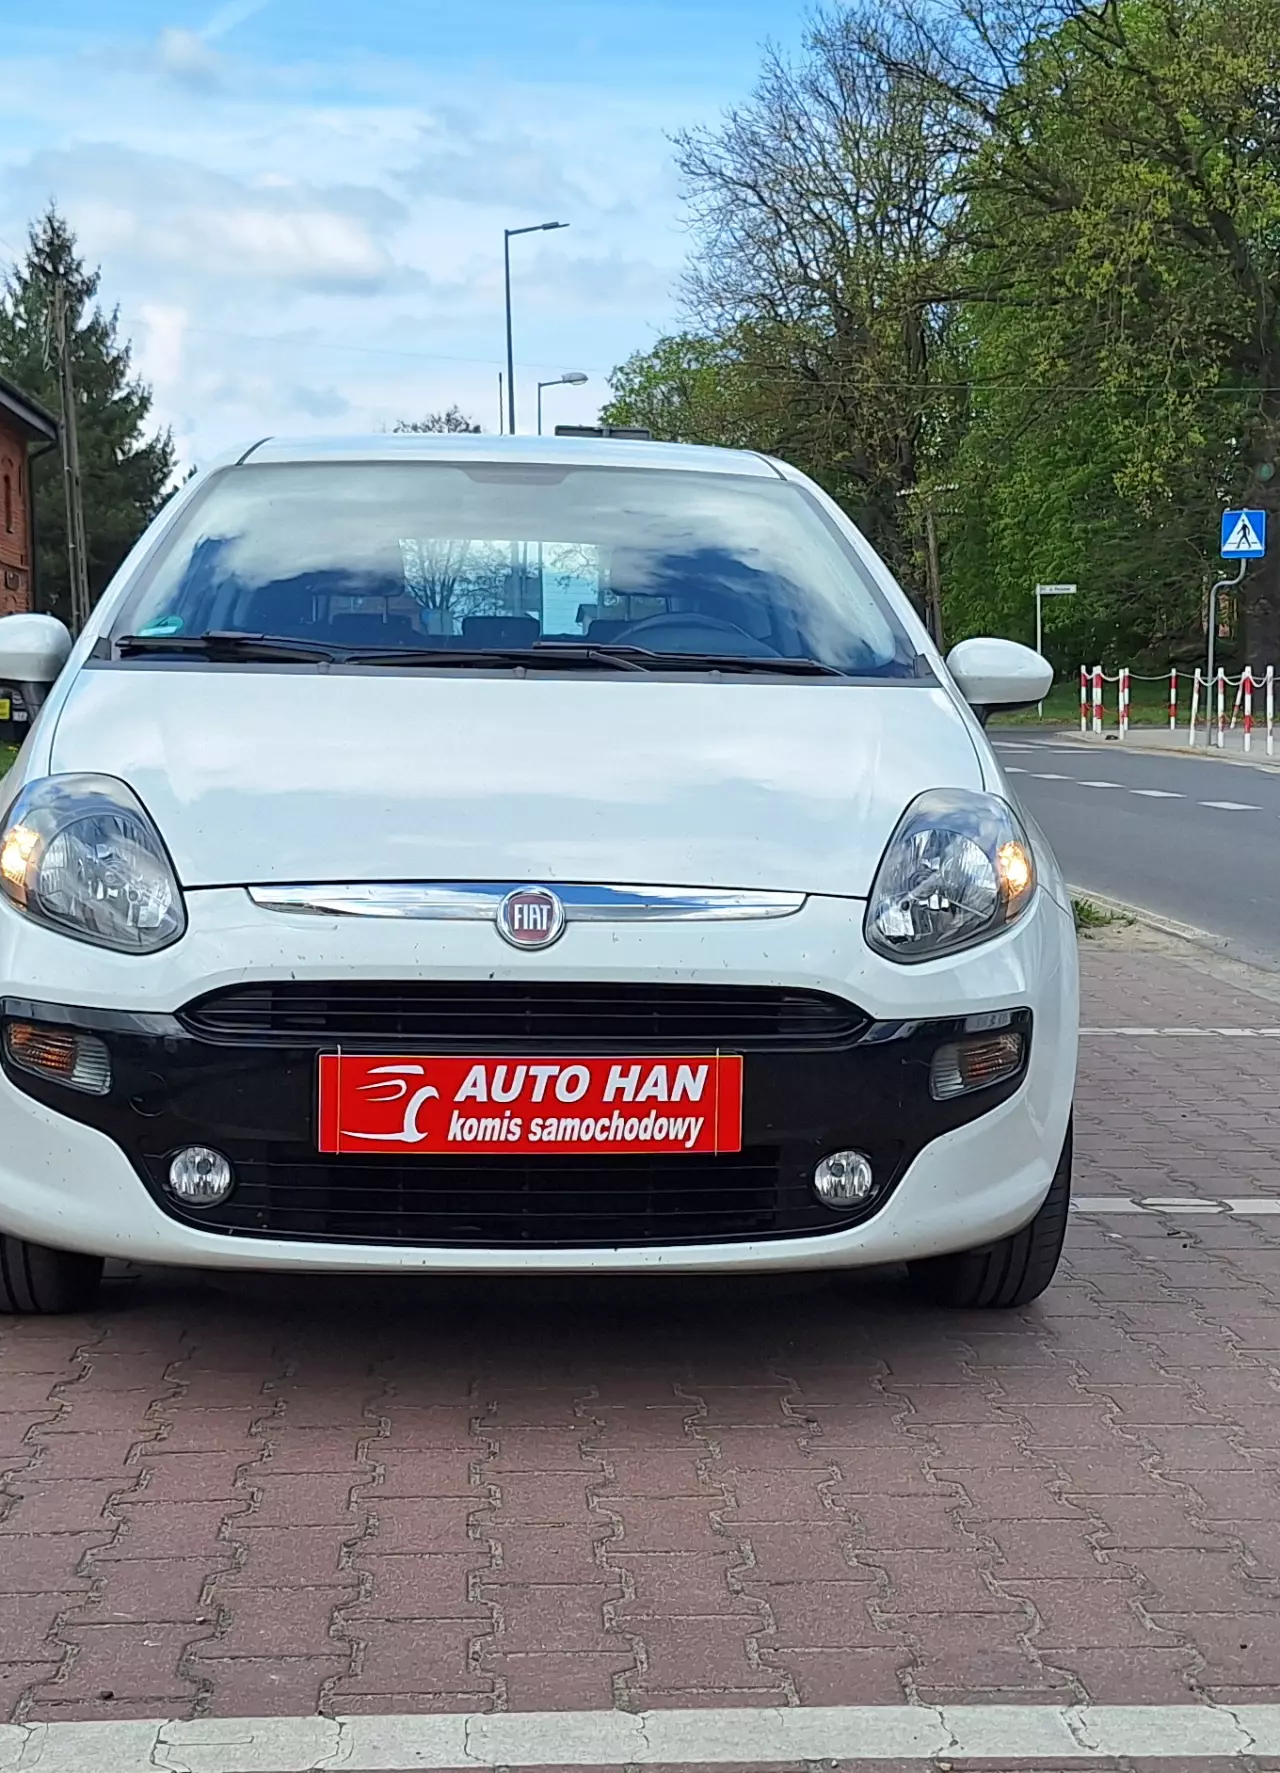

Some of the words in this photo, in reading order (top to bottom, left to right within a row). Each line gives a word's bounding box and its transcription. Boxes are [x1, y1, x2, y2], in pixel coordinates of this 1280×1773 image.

[513, 903, 551, 931] FIAT
[454, 1064, 590, 1103] AUTO
[602, 1064, 709, 1102] HAN
[447, 1110, 522, 1142] komis
[528, 1110, 704, 1149] samochodowy
